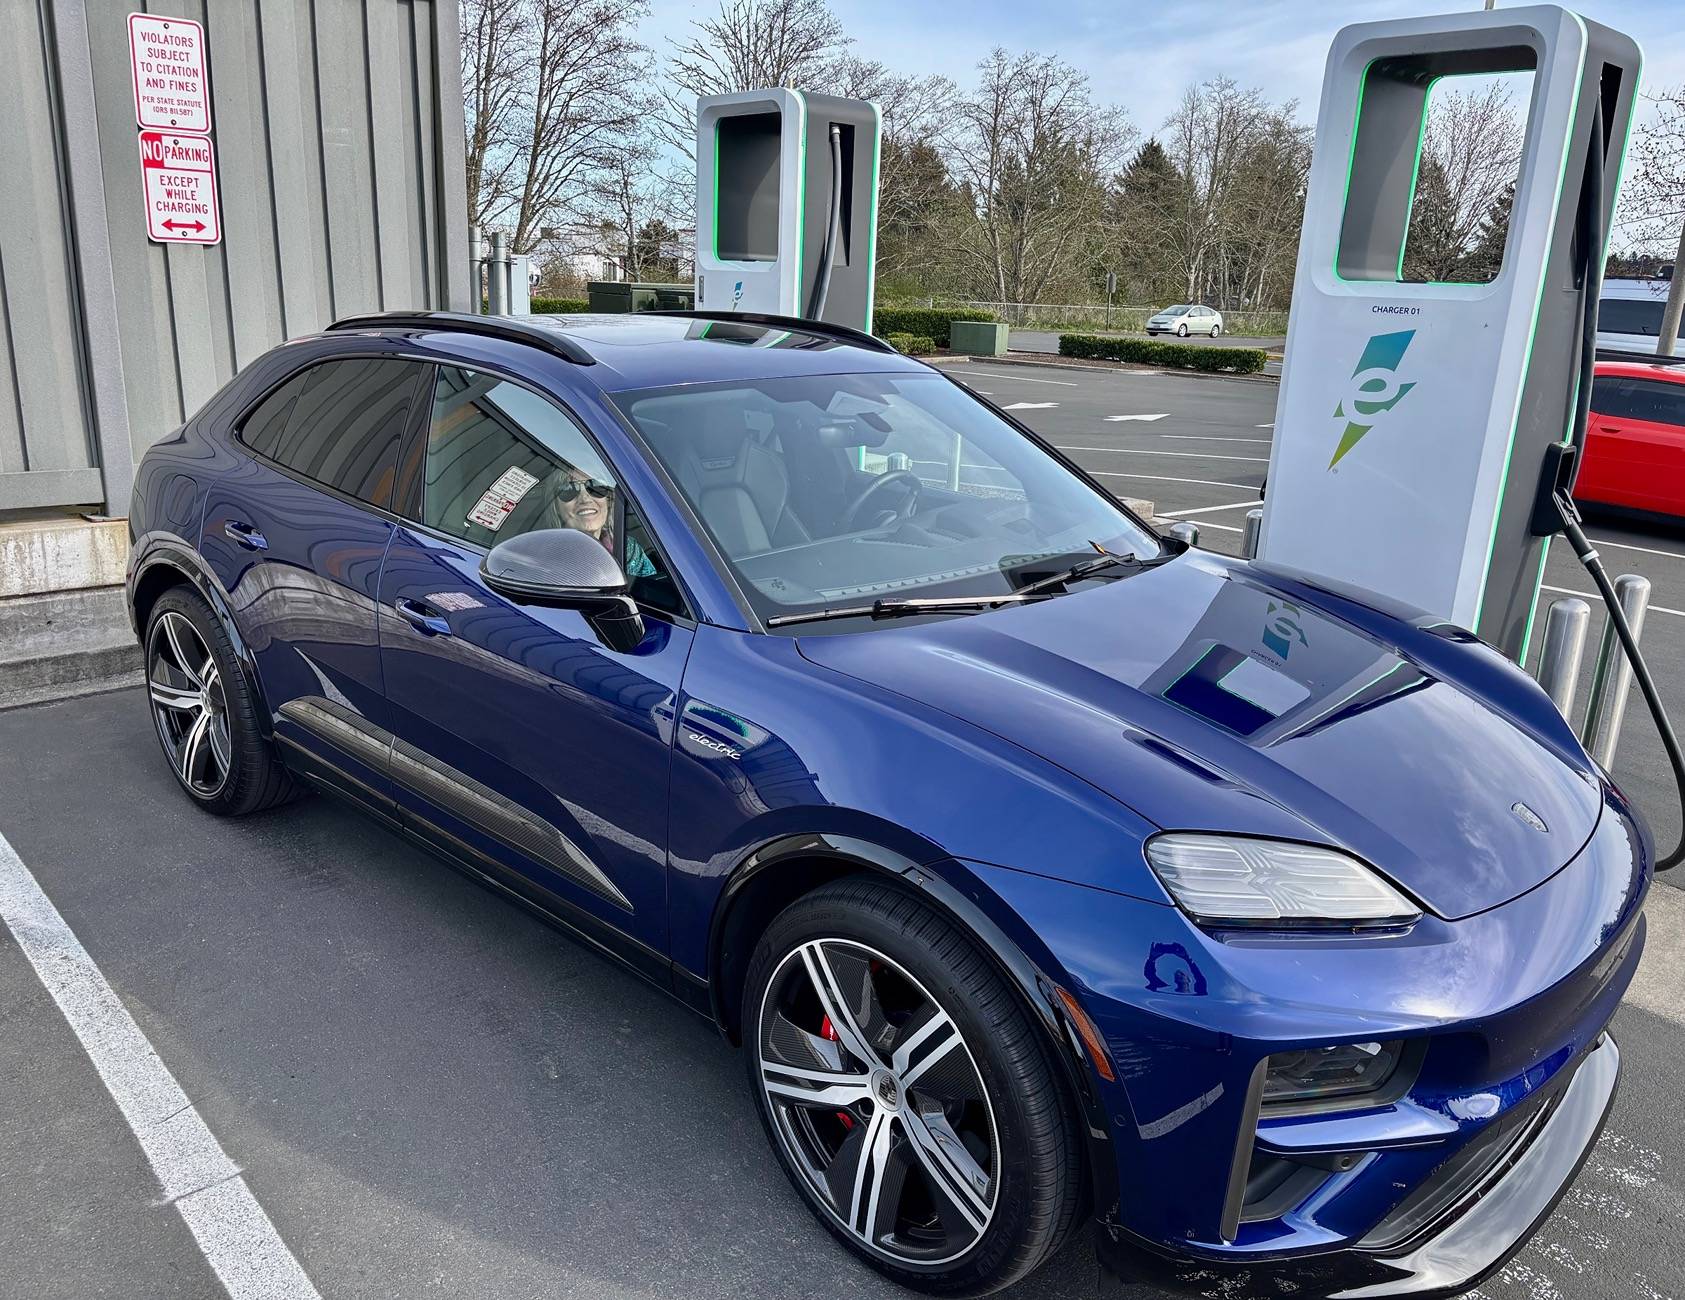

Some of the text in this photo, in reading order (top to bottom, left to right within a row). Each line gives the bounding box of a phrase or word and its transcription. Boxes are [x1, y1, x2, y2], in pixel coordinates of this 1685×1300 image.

[140, 31, 194, 48] VIOLATORS
[147, 47, 191, 62] SUBJECT
[140, 62, 199, 78] TO CITATION
[146, 77, 197, 93] AND FINES
[142, 95, 202, 109] PER STATE STATUTE
[152, 105, 168, 114] (ORS
[142, 139, 209, 163] NO PARKING
[159, 174, 200, 188] EXCEPT
[165, 188, 197, 201] WHILE
[156, 200, 209, 215] CHARGING
[1372, 305, 1420, 315] CHARGER 01
[688, 733, 741, 760] electric
